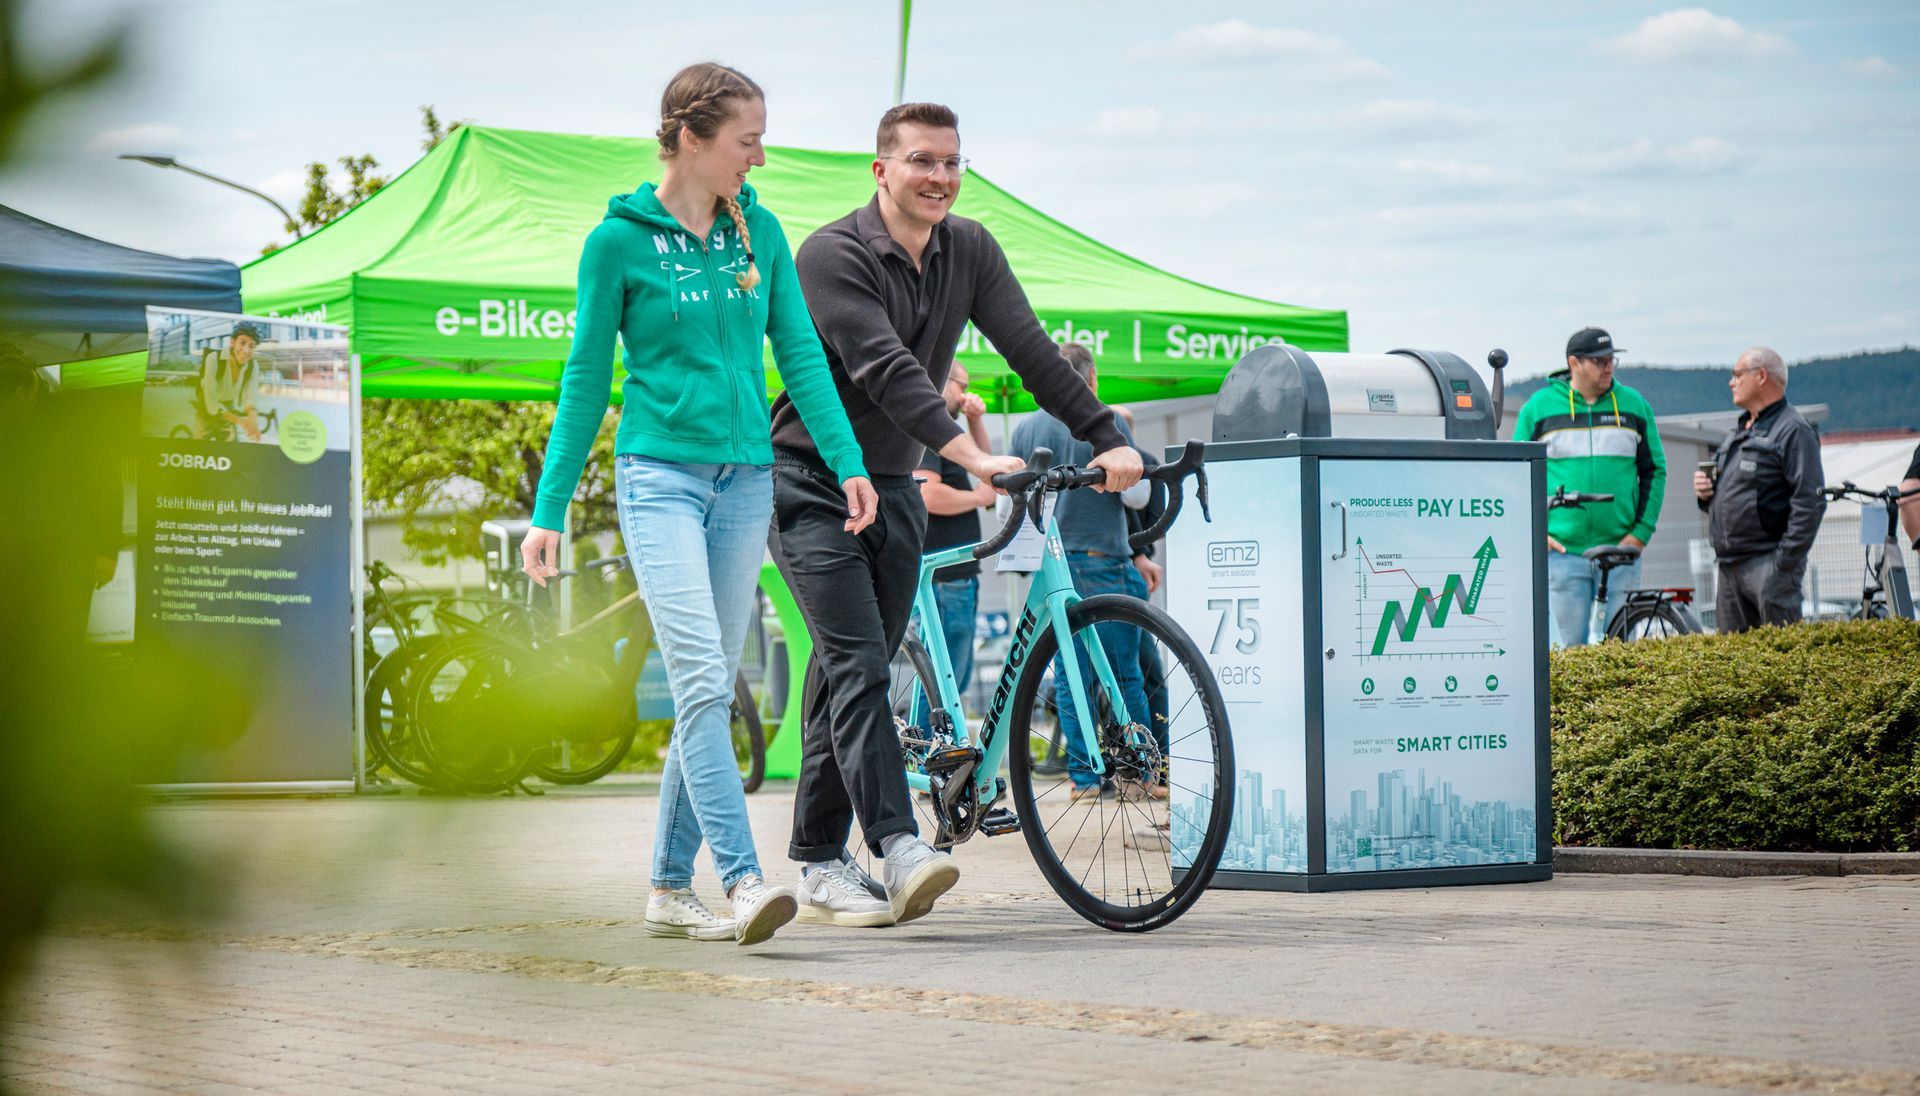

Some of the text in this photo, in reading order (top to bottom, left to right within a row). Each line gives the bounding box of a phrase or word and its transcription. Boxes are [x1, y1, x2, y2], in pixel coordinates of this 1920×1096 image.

[1166, 324, 1285, 360] Servi
[158, 453, 232, 471] JOBRAD
[156, 496, 184, 509] Steht
[185, 497, 214, 511] Ihnen
[240, 499, 255, 512] Ihr
[257, 502, 287, 515] neues
[288, 503, 333, 518] JobRad!
[1350, 498, 1505, 517] PRODUCE LESS PAY LESS
[1350, 510, 1384, 518] UNSORTED
[220, 523, 238, 532] und
[198, 535, 209, 543] im
[240, 536, 251, 545] im
[1211, 546, 1256, 562] emz
[1211, 569, 1256, 578] smart solutions
[1469, 547, 1490, 608] SEPARATED WASTE
[216, 590, 233, 600] und
[1207, 598, 1262, 655] 75
[979, 603, 1037, 751] Bianchi
[1397, 736, 1452, 753] SMART
[1457, 734, 1507, 750] CITIES
